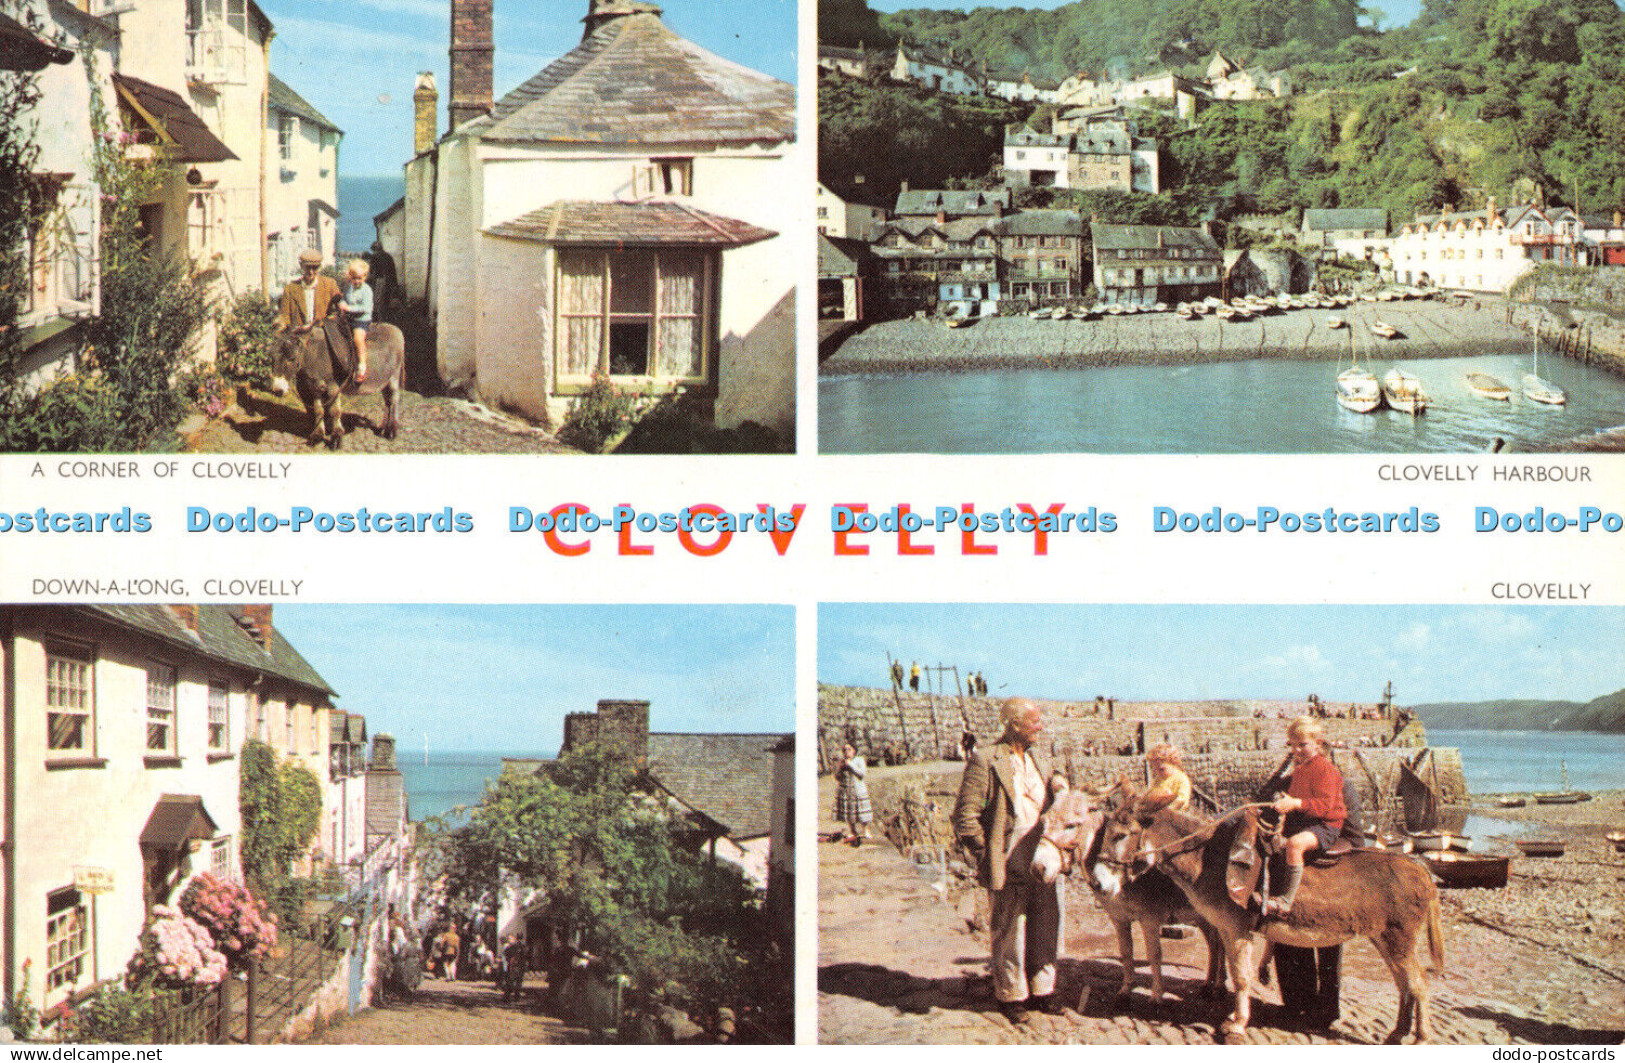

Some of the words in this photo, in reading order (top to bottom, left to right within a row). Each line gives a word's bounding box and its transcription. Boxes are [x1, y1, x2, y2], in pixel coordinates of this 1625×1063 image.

[31, 461, 44, 478] A
[58, 461, 140, 478] CORNER
[153, 461, 178, 478] OF
[192, 461, 291, 479] CLOVELLY
[1378, 464, 1478, 482] CLOVELLY
[1493, 464, 1592, 482] HARBOUR
[543, 502, 1066, 557] CLOVELLY
[203, 578, 303, 596] CLOVELLY
[1491, 582, 1591, 599] CLOVELLY
